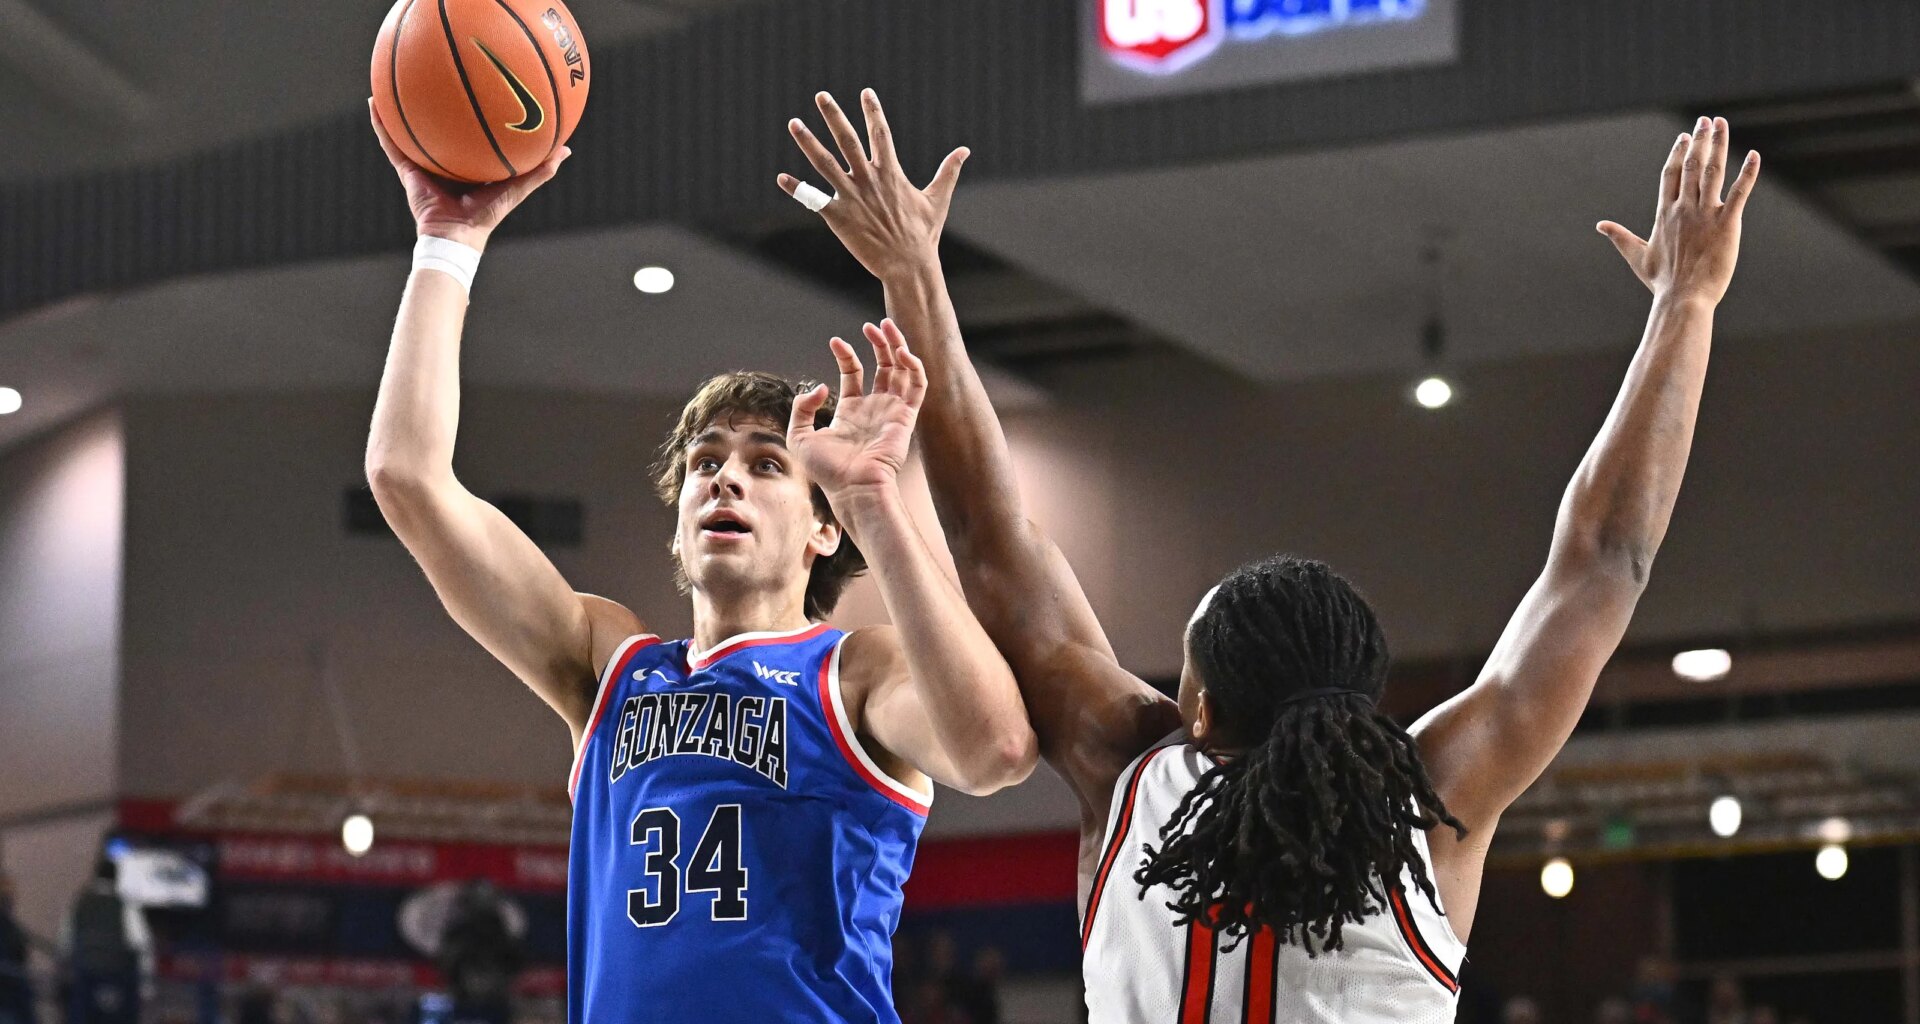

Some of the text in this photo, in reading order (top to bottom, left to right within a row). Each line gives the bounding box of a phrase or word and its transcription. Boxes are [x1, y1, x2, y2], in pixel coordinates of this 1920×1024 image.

[752, 660, 801, 687] WCC
[610, 692, 789, 791] GONZAGA
[627, 804, 748, 928] 34
